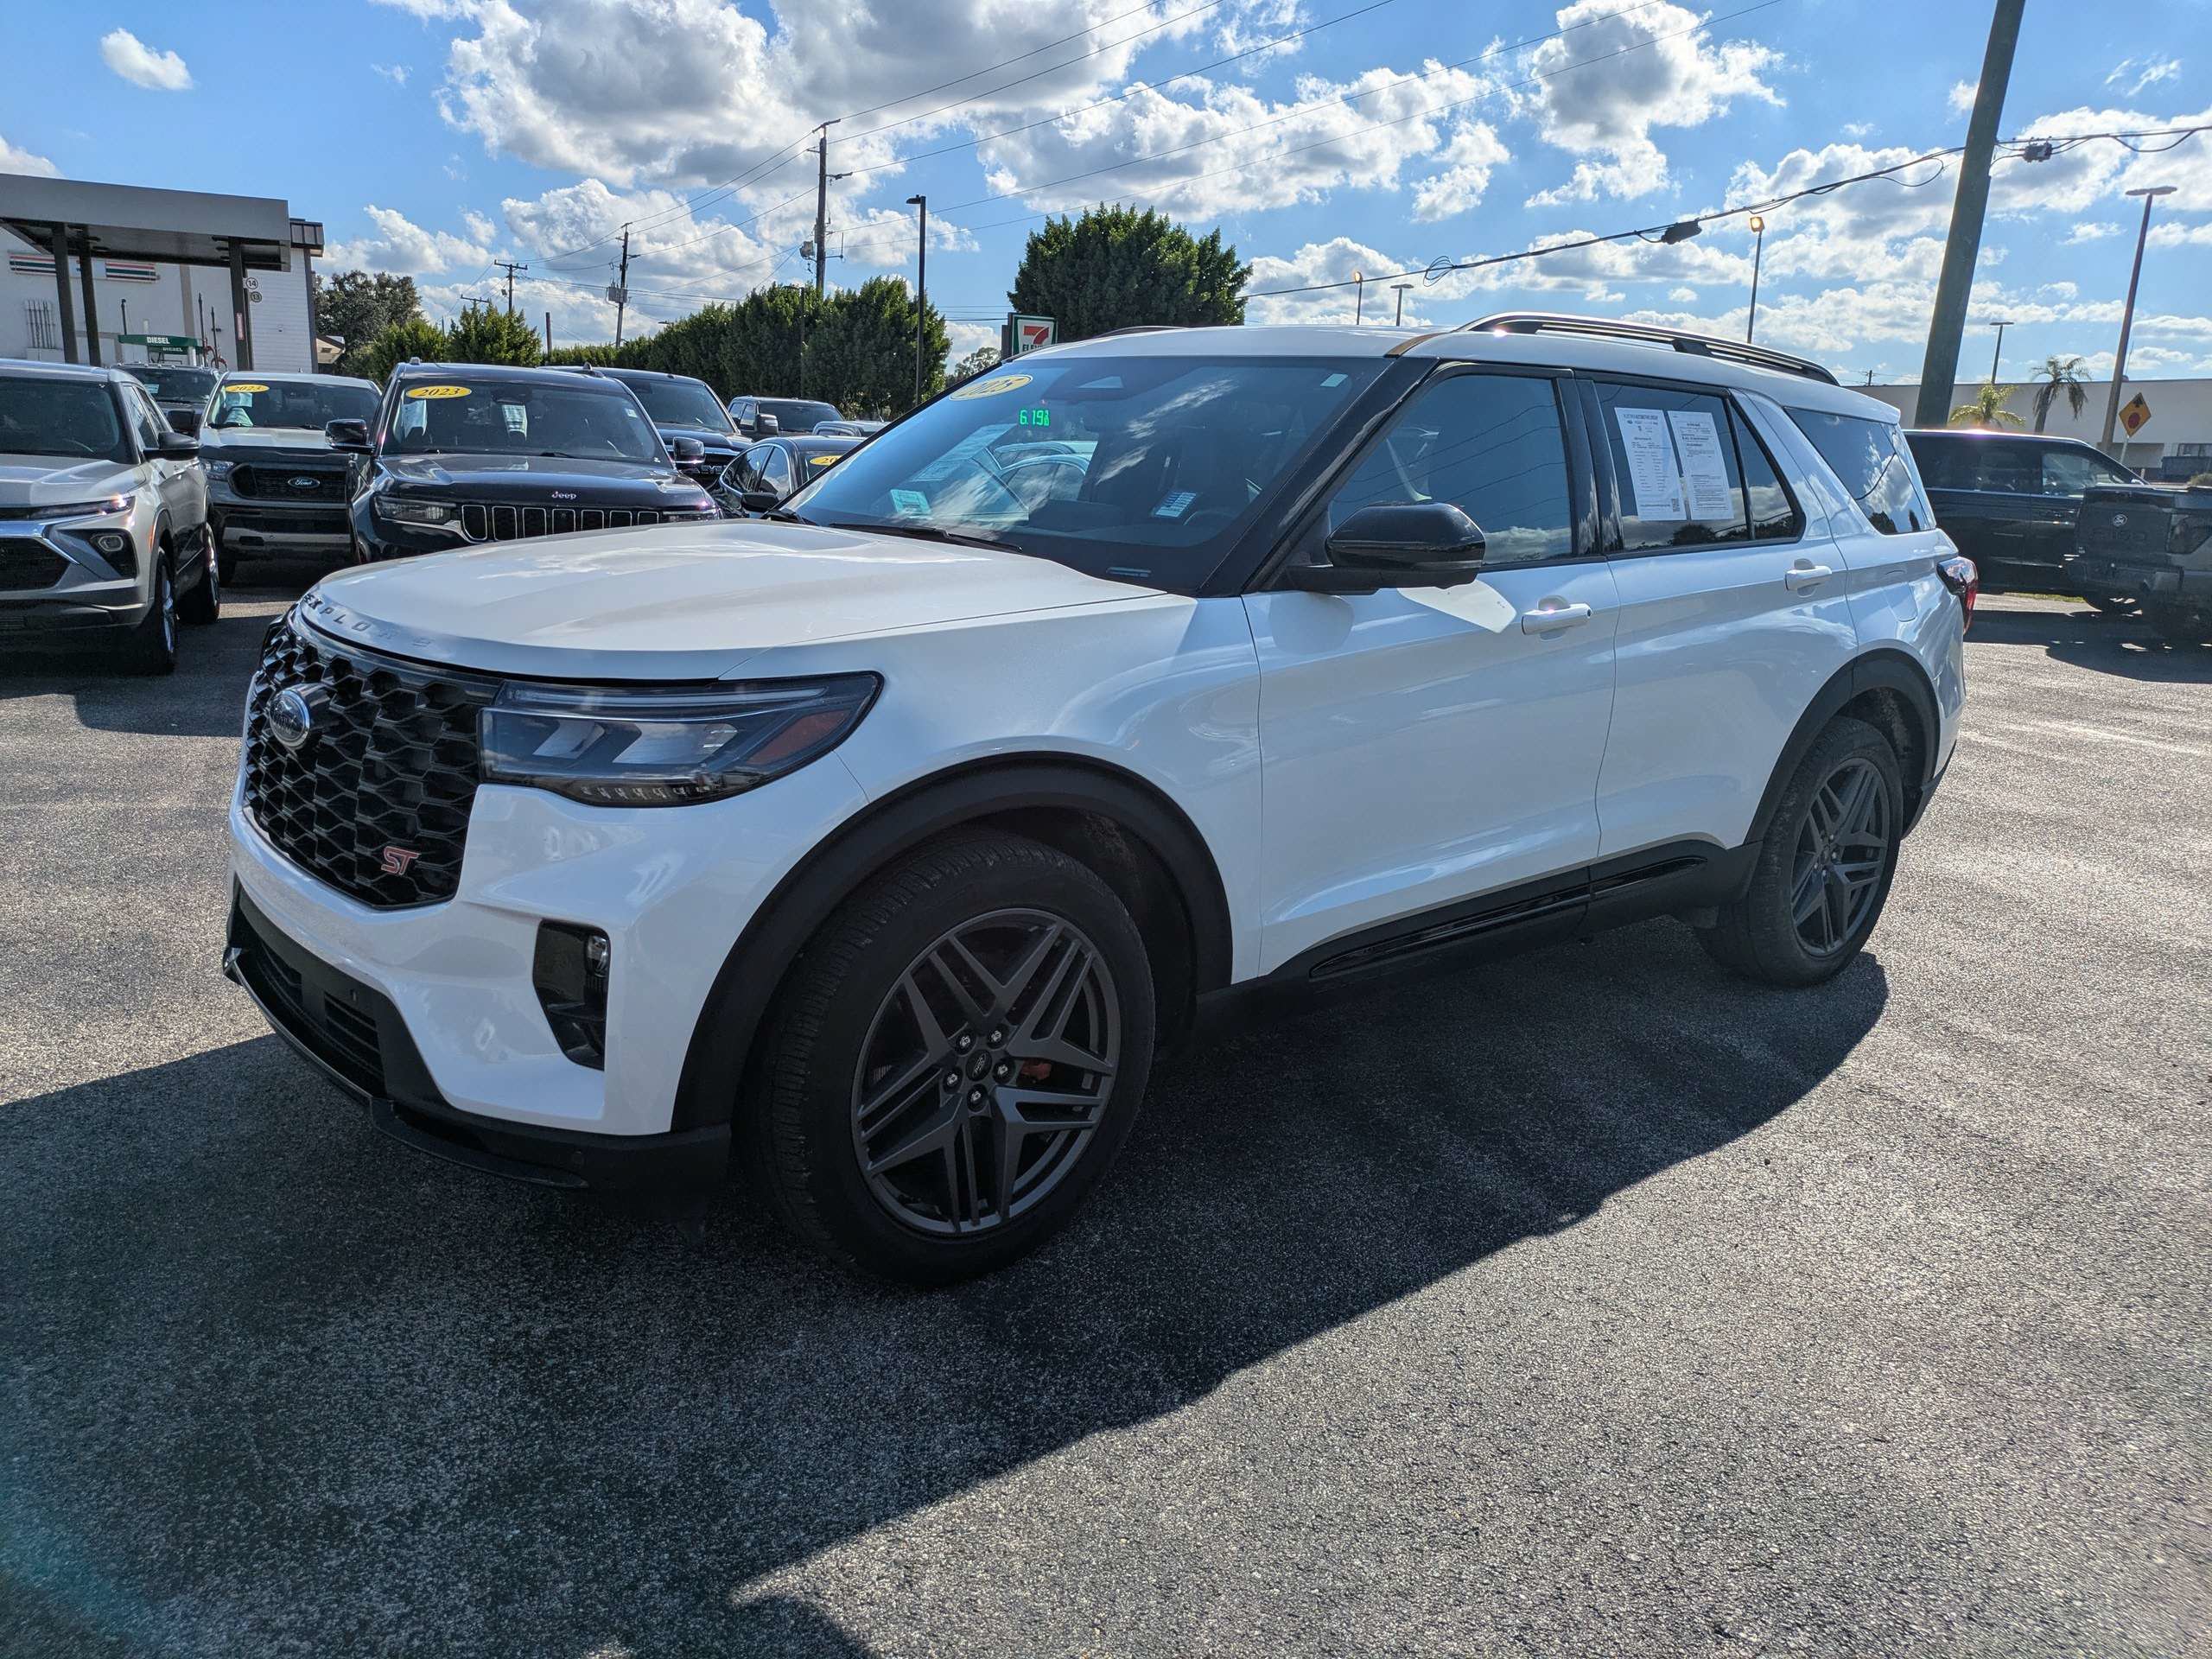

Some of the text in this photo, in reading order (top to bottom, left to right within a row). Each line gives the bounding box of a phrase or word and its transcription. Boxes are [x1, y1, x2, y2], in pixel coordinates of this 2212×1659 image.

[1023, 325, 1049, 346] 7
[146, 336, 170, 345] DIESEL
[417, 388, 461, 397] 2023
[551, 491, 577, 500] Jeep
[380, 846, 422, 875] ST
